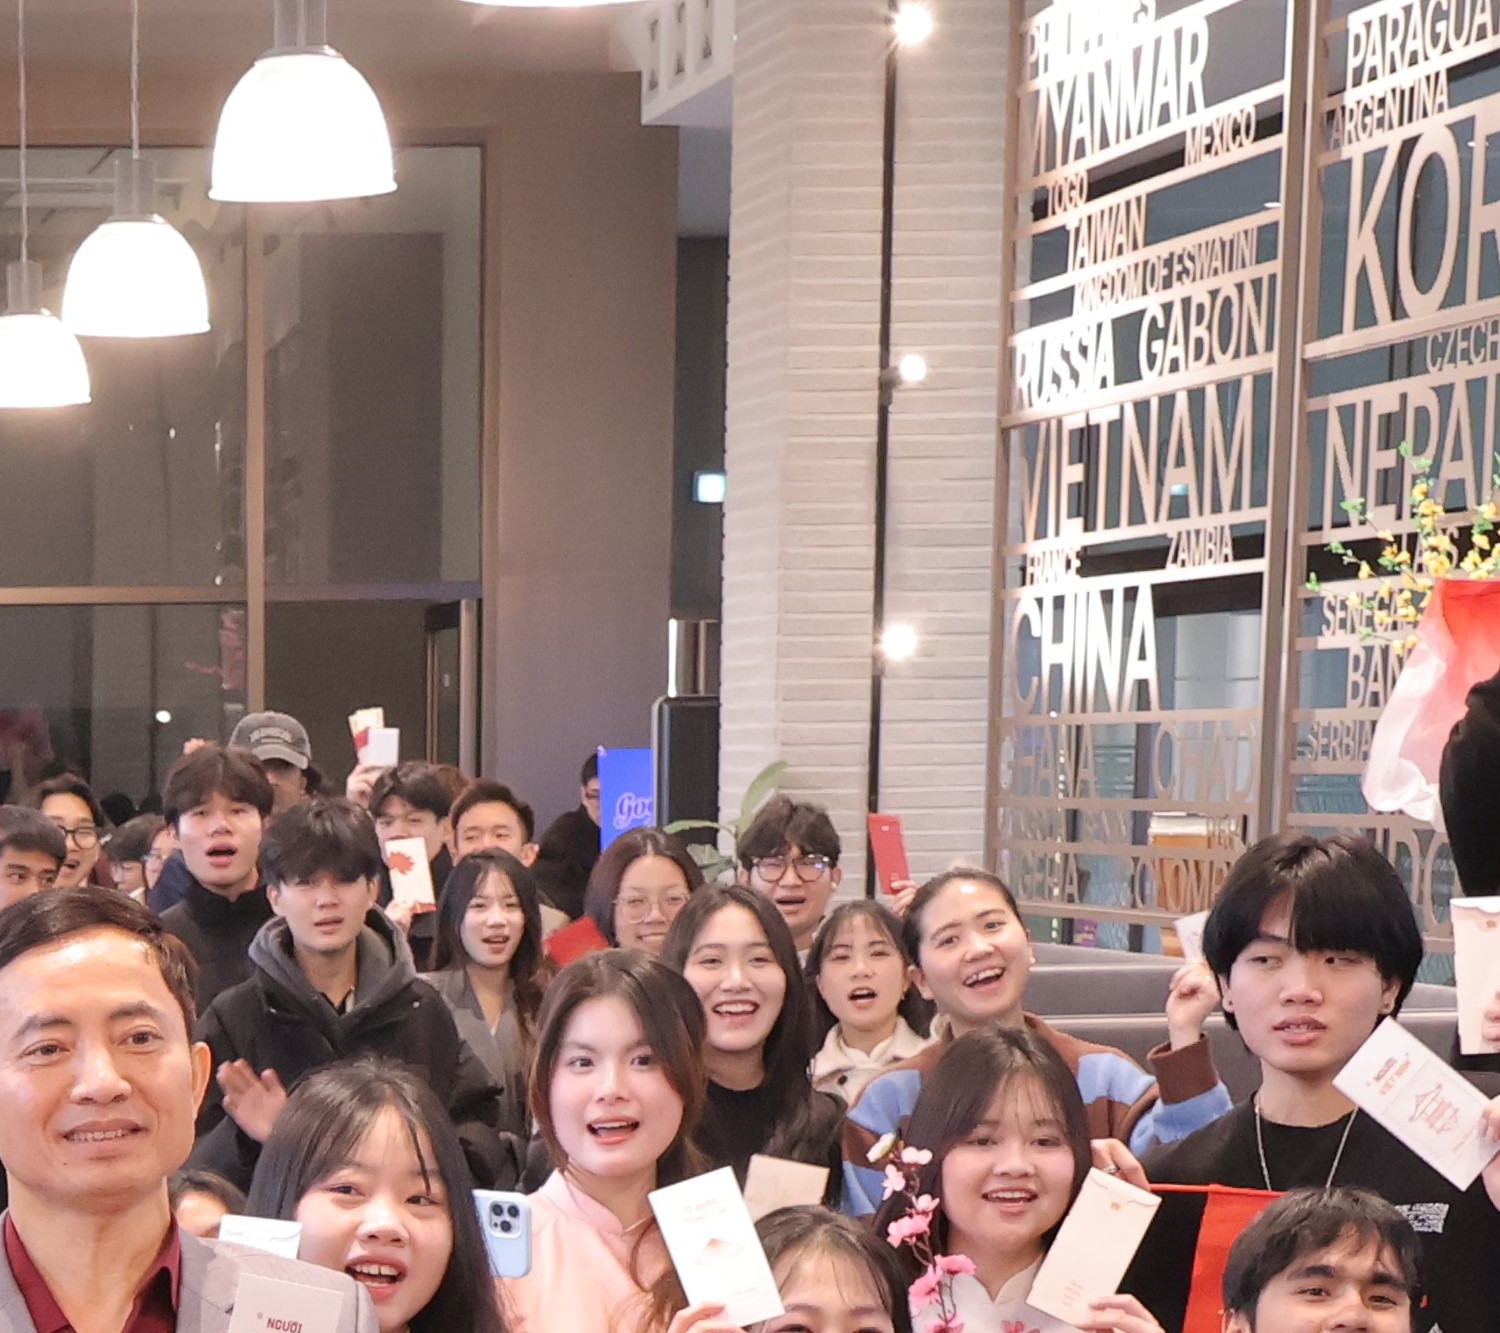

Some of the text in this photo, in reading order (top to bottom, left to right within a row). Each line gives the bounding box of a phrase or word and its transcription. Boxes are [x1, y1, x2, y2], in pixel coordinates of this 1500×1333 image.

[1184, 105, 1256, 165] MEXICO
[1331, 69, 1448, 148] ARGENTINA
[1048, 170, 1088, 217] TOGO
[1065, 194, 1148, 272] TAIWAN
[1074, 225, 1258, 316] KINGDOM OF ESWATINI
[1016, 273, 1268, 409] RUSSIA GABON
[1020, 373, 1253, 542] VIETNAM
[1026, 545, 1081, 584] FRANCE
[1167, 524, 1232, 569] ZAMBIA
[1012, 584, 1160, 715] CHINA
